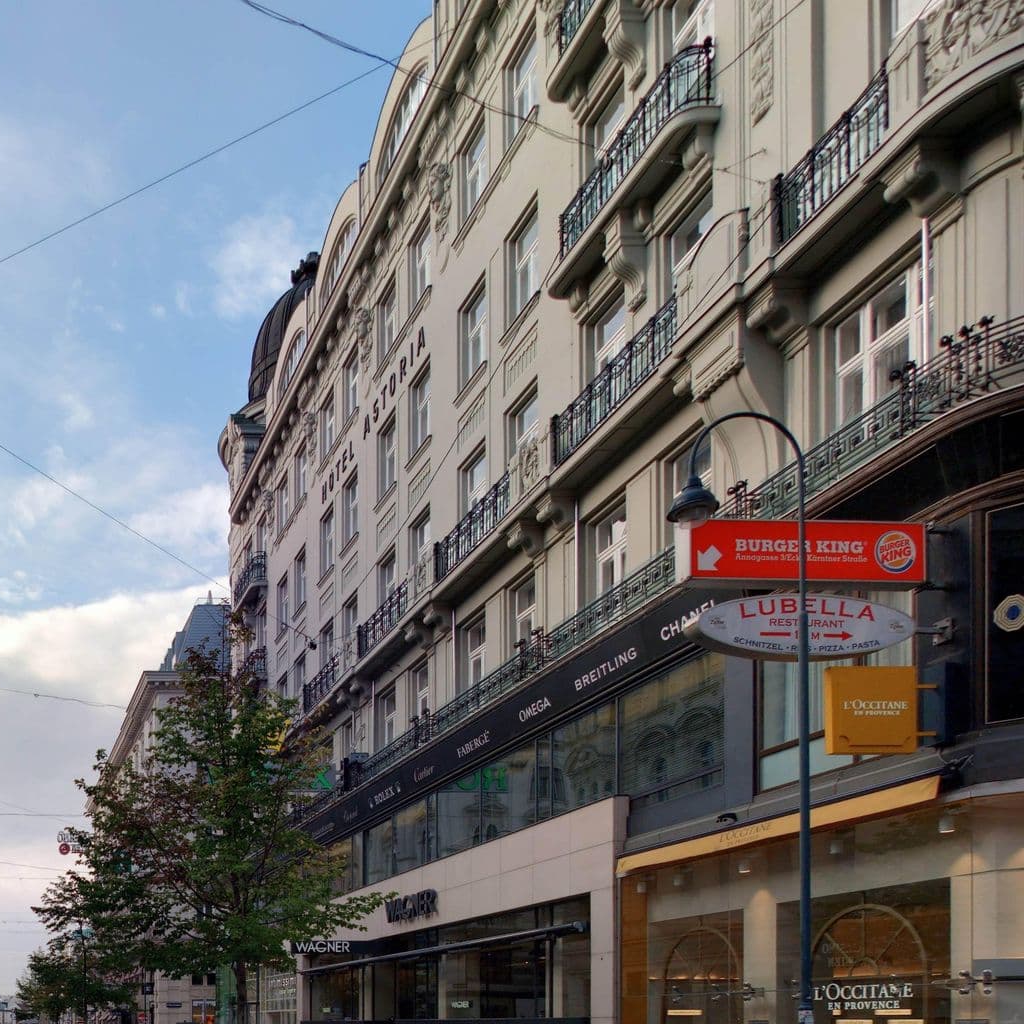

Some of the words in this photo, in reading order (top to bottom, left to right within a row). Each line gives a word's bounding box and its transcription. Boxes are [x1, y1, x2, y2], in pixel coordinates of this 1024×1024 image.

[321, 441, 355, 504] HOTEL
[363, 326, 426, 440] ASTORIA
[816, 540, 864, 554] KING
[879, 538, 910, 550] BURGER
[880, 547, 912, 564] KING
[739, 598, 875, 622] LUBELLA
[769, 618, 845, 628] RESTURANT
[733, 636, 783, 651] SCHNITZEL
[791, 644, 812, 653] RS
[819, 644, 844, 652] PIZZA
[851, 639, 880, 650] PASTA
[574, 647, 638, 692] BREITLING
[518, 697, 552, 723] OMEGA
[843, 699, 908, 710] L'OCCITANE
[385, 888, 439, 923] WAGNER
[296, 941, 351, 953] WAGNER
[827, 1002, 841, 1010] EN
[844, 1001, 900, 1010] PROVENCE
